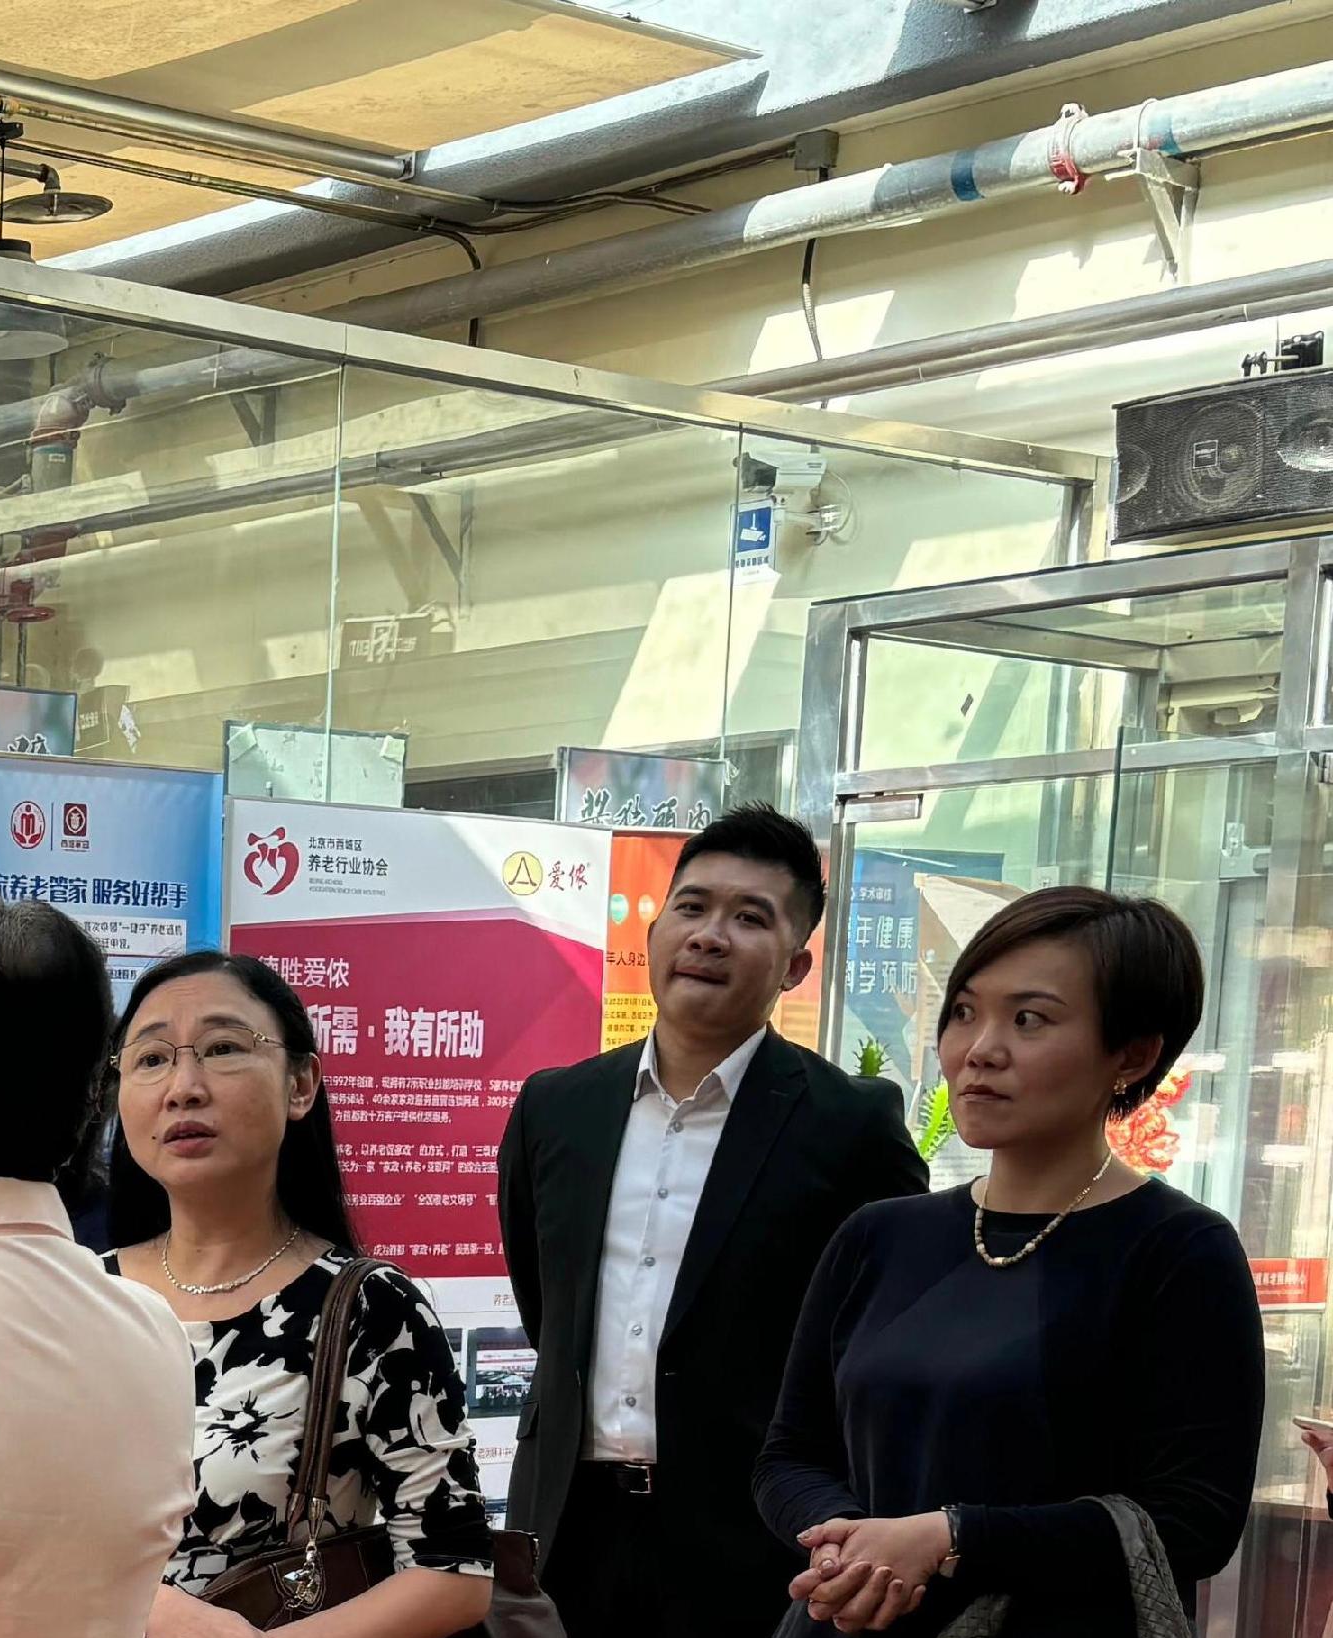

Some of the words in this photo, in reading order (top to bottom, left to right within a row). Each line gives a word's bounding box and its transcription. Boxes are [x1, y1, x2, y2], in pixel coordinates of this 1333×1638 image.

[308, 854, 388, 876] 养老行业协会
[93, 877, 188, 908] 服务好帮手
[849, 915, 915, 949] 年健康
